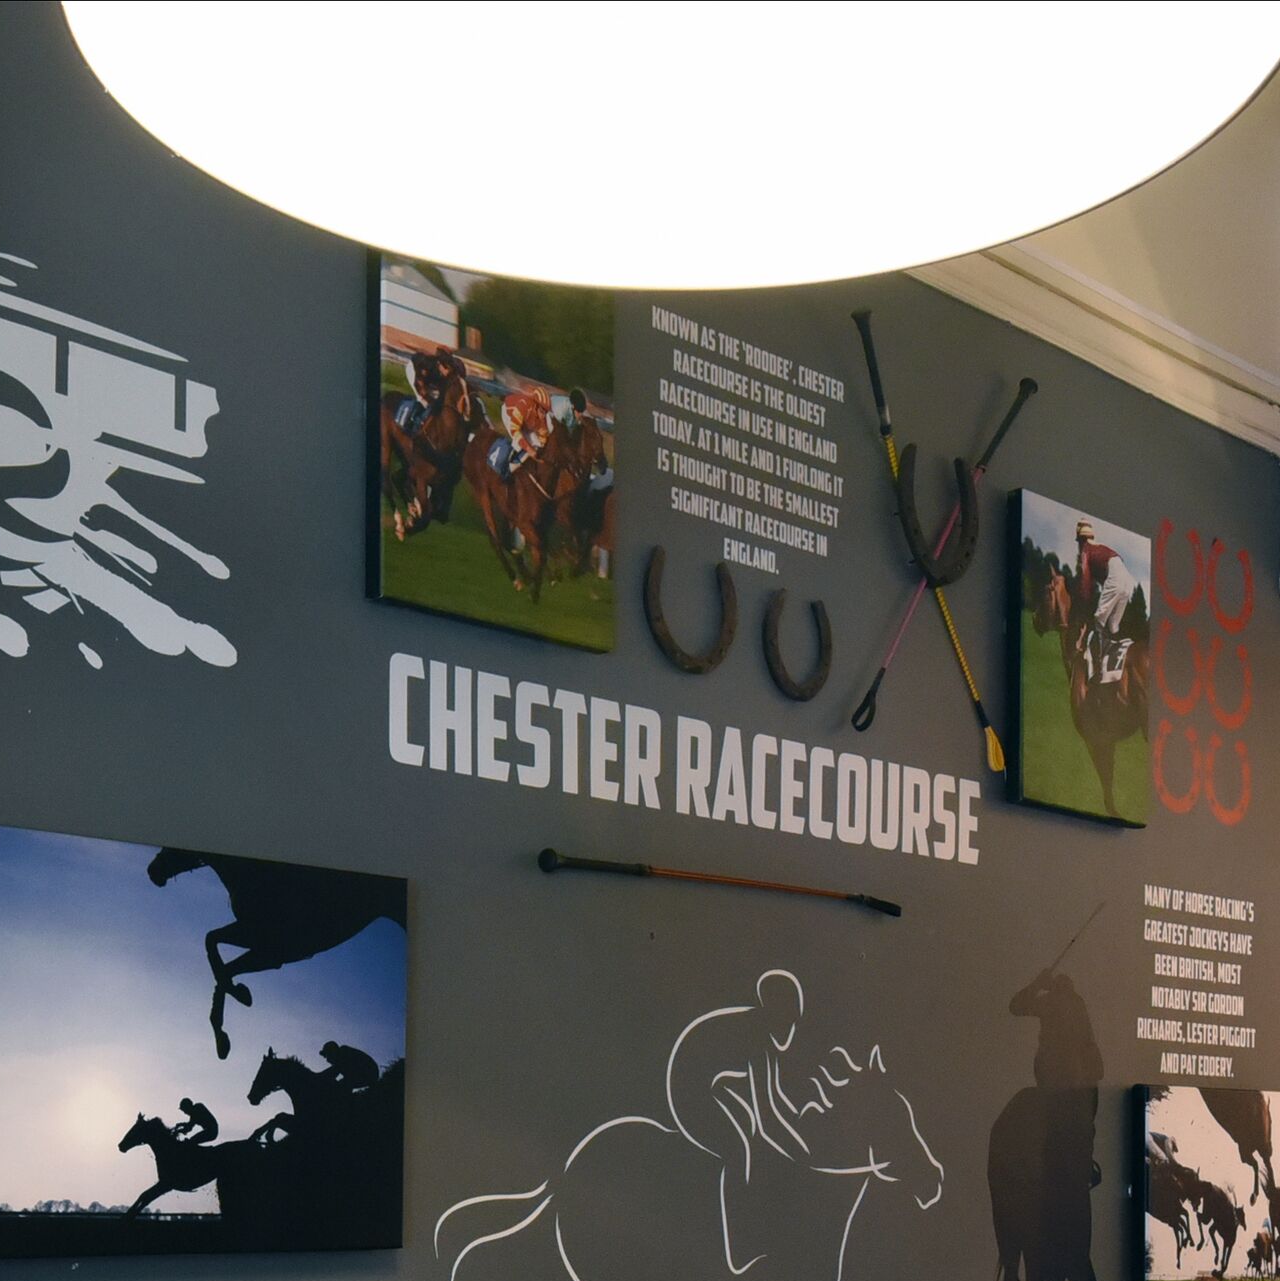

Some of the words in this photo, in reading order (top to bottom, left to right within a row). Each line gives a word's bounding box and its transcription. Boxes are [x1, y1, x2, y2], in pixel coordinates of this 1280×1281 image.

[652, 306, 698, 345] KNOWN
[701, 326, 715, 350] AS
[719, 333, 739, 361] THE
[799, 366, 844, 403] CHESTER
[674, 349, 748, 394] RACECOURSE
[751, 379, 761, 400] IS
[764, 385, 783, 411] THE
[786, 394, 826, 427] OLDEST
[660, 379, 735, 423] RACECOURSE
[739, 408, 750, 431] IN
[752, 415, 773, 440] USE
[776, 424, 786, 446] IN
[789, 430, 837, 464] ENGLAND
[658, 448, 669, 471] IS
[672, 453, 727, 491] THOUGHT
[730, 472, 744, 496] TO
[747, 478, 761, 502] BE
[764, 484, 783, 509] THE
[786, 491, 839, 528] SMALLEST
[698, 428, 712, 450] AT
[714, 434, 719, 453] 1
[722, 436, 748, 464] MILE
[751, 446, 773, 474] AND
[776, 456, 781, 477] 1
[783, 459, 832, 493] FURLONG
[834, 476, 843, 497] IT
[671, 487, 742, 530] SIGNIFICANT
[745, 511, 814, 553] RACECOURSE
[817, 534, 827, 556] IN
[388, 652, 661, 810] CHESTER
[675, 715, 981, 865] RACECOURSE
[1144, 919, 1188, 945] GREATEST
[1189, 927, 1229, 952] JOCKEYS
[1230, 934, 1252, 955] HAVE
[1145, 885, 1171, 910] MANY
[1173, 890, 1184, 911] OF
[1185, 892, 1214, 916] HORSE
[1215, 897, 1254, 922] RACING'S
[1152, 986, 1191, 1011] NOTABLY
[1192, 991, 1207, 1012] SIR
[1209, 993, 1244, 1016] GORDON
[1155, 954, 1177, 977] BEEN
[1218, 963, 1241, 985] MOST
[1160, 1053, 1178, 1074] AND
[1180, 1054, 1197, 1075] PAT
[1187, 1022, 1218, 1045] LESTER
[1220, 1025, 1256, 1048] PIGGOTT
